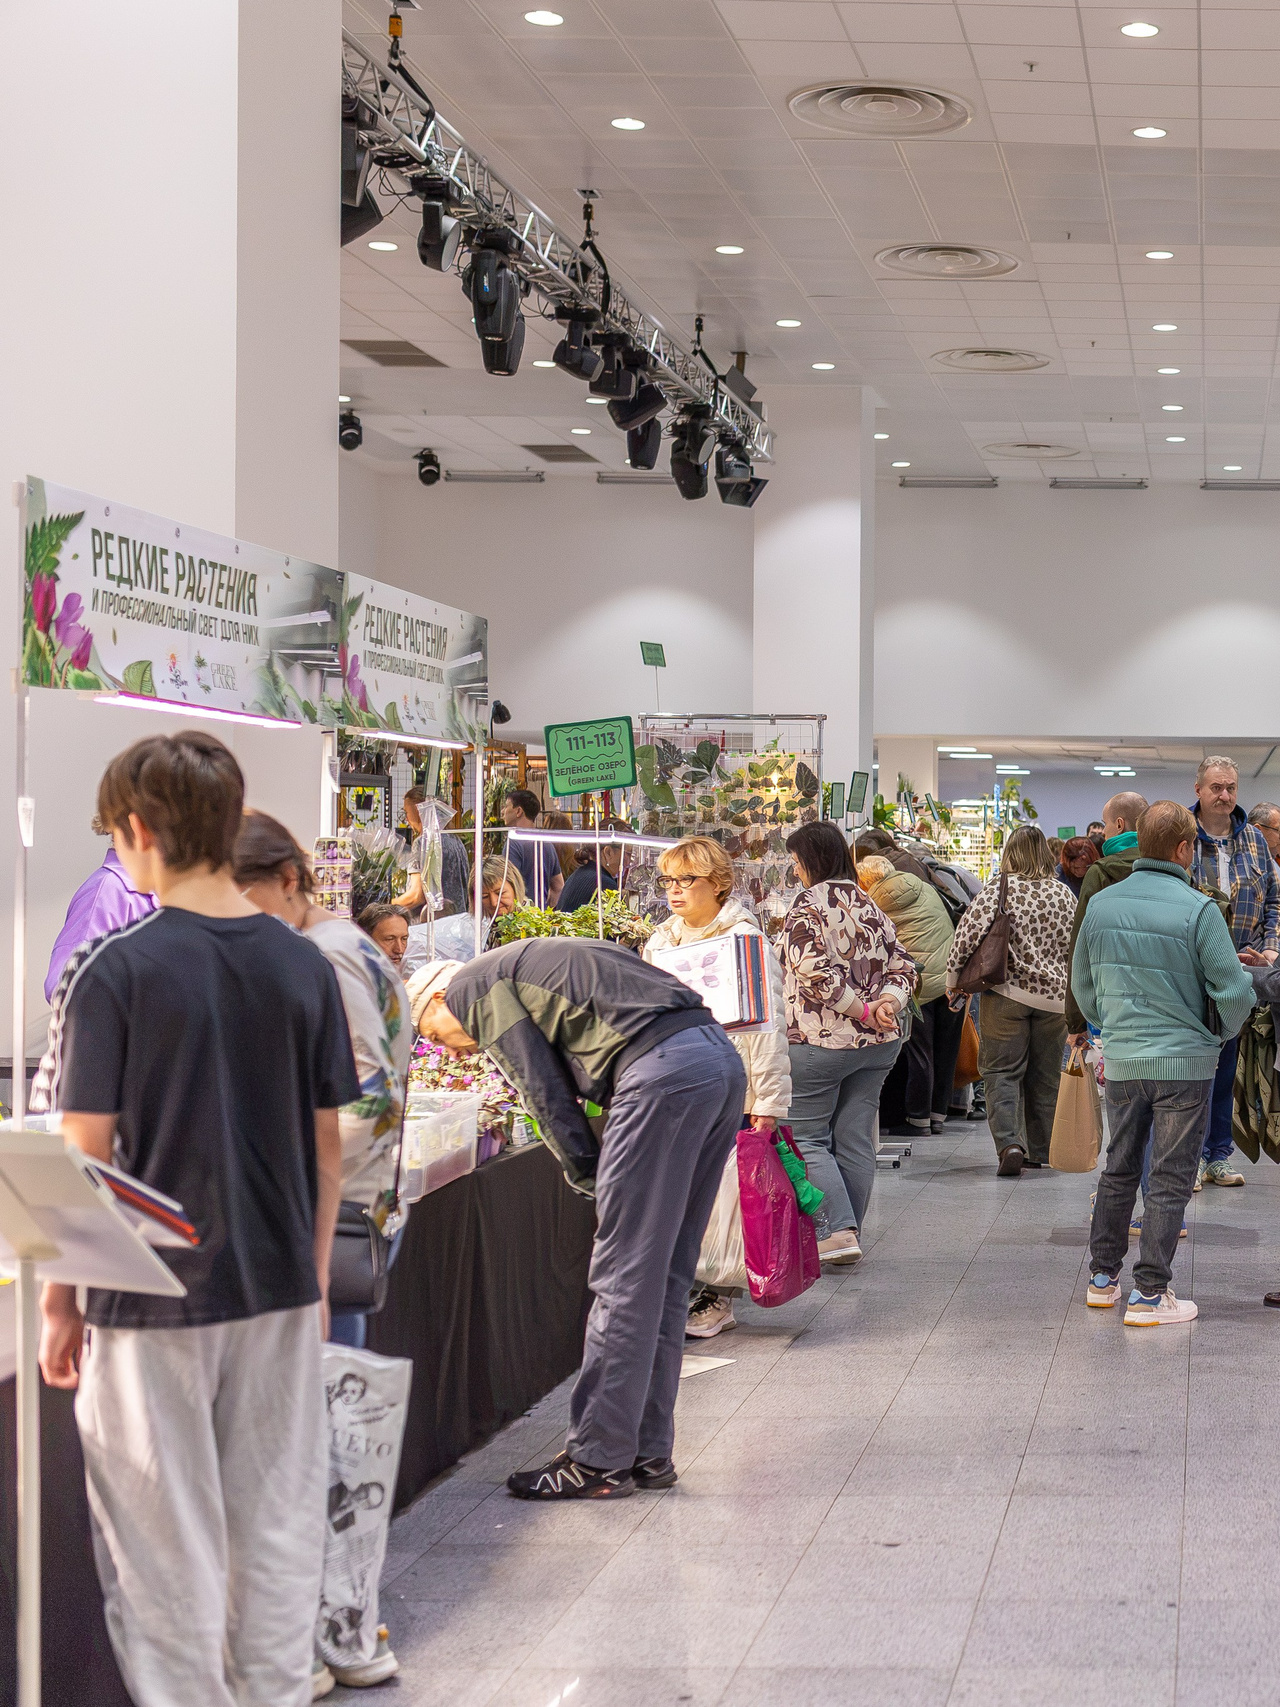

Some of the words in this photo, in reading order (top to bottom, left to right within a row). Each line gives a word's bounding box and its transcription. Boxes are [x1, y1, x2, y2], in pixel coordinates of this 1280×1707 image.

[91, 528, 169, 595] РЕДКИЕ
[174, 551, 258, 617] РАСТЕНИЯ
[92, 588, 99, 611] И
[100, 589, 196, 633] ПРОФЕССИОНАЛЬНЫЙ
[198, 613, 218, 638] СВЕТ
[220, 618, 241, 642] ДЛЯ
[241, 623, 259, 646] НИХ
[363, 603, 401, 650] РЕДКИЕ
[404, 615, 448, 661] РАСТЕНИЯ
[566, 731, 616, 751] 111-113
[555, 764, 596, 776] ЗЕЛЁНОЕ
[598, 759, 627, 771] ОЗЕРО
[568, 776, 594, 786] (GREEN
[596, 770, 616, 782] LAKE)
